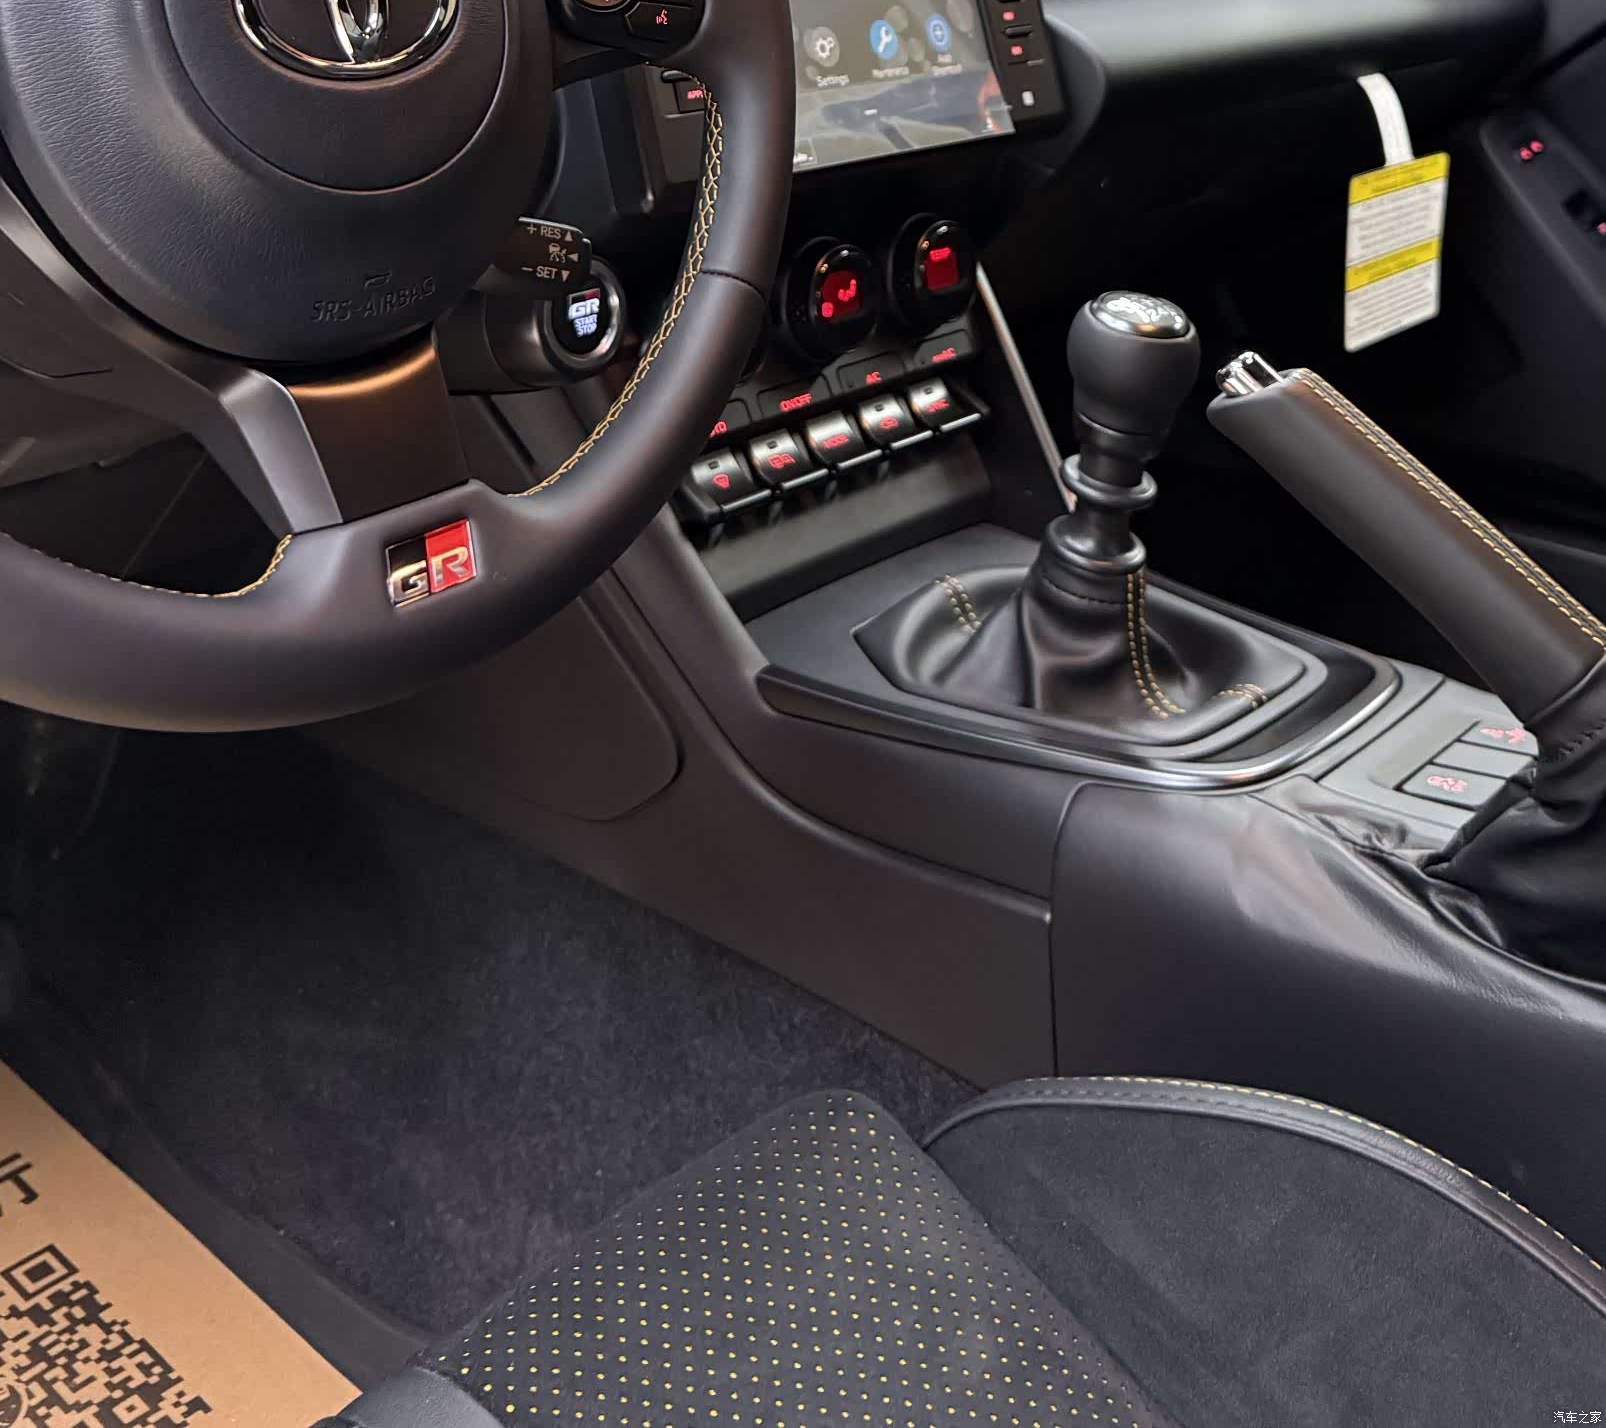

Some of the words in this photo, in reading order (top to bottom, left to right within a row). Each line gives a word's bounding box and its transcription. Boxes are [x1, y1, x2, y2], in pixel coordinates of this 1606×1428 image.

[540, 225, 561, 240] RES
[536, 265, 558, 280] SET
[567, 297, 600, 321] GR
[387, 546, 474, 606] GR
